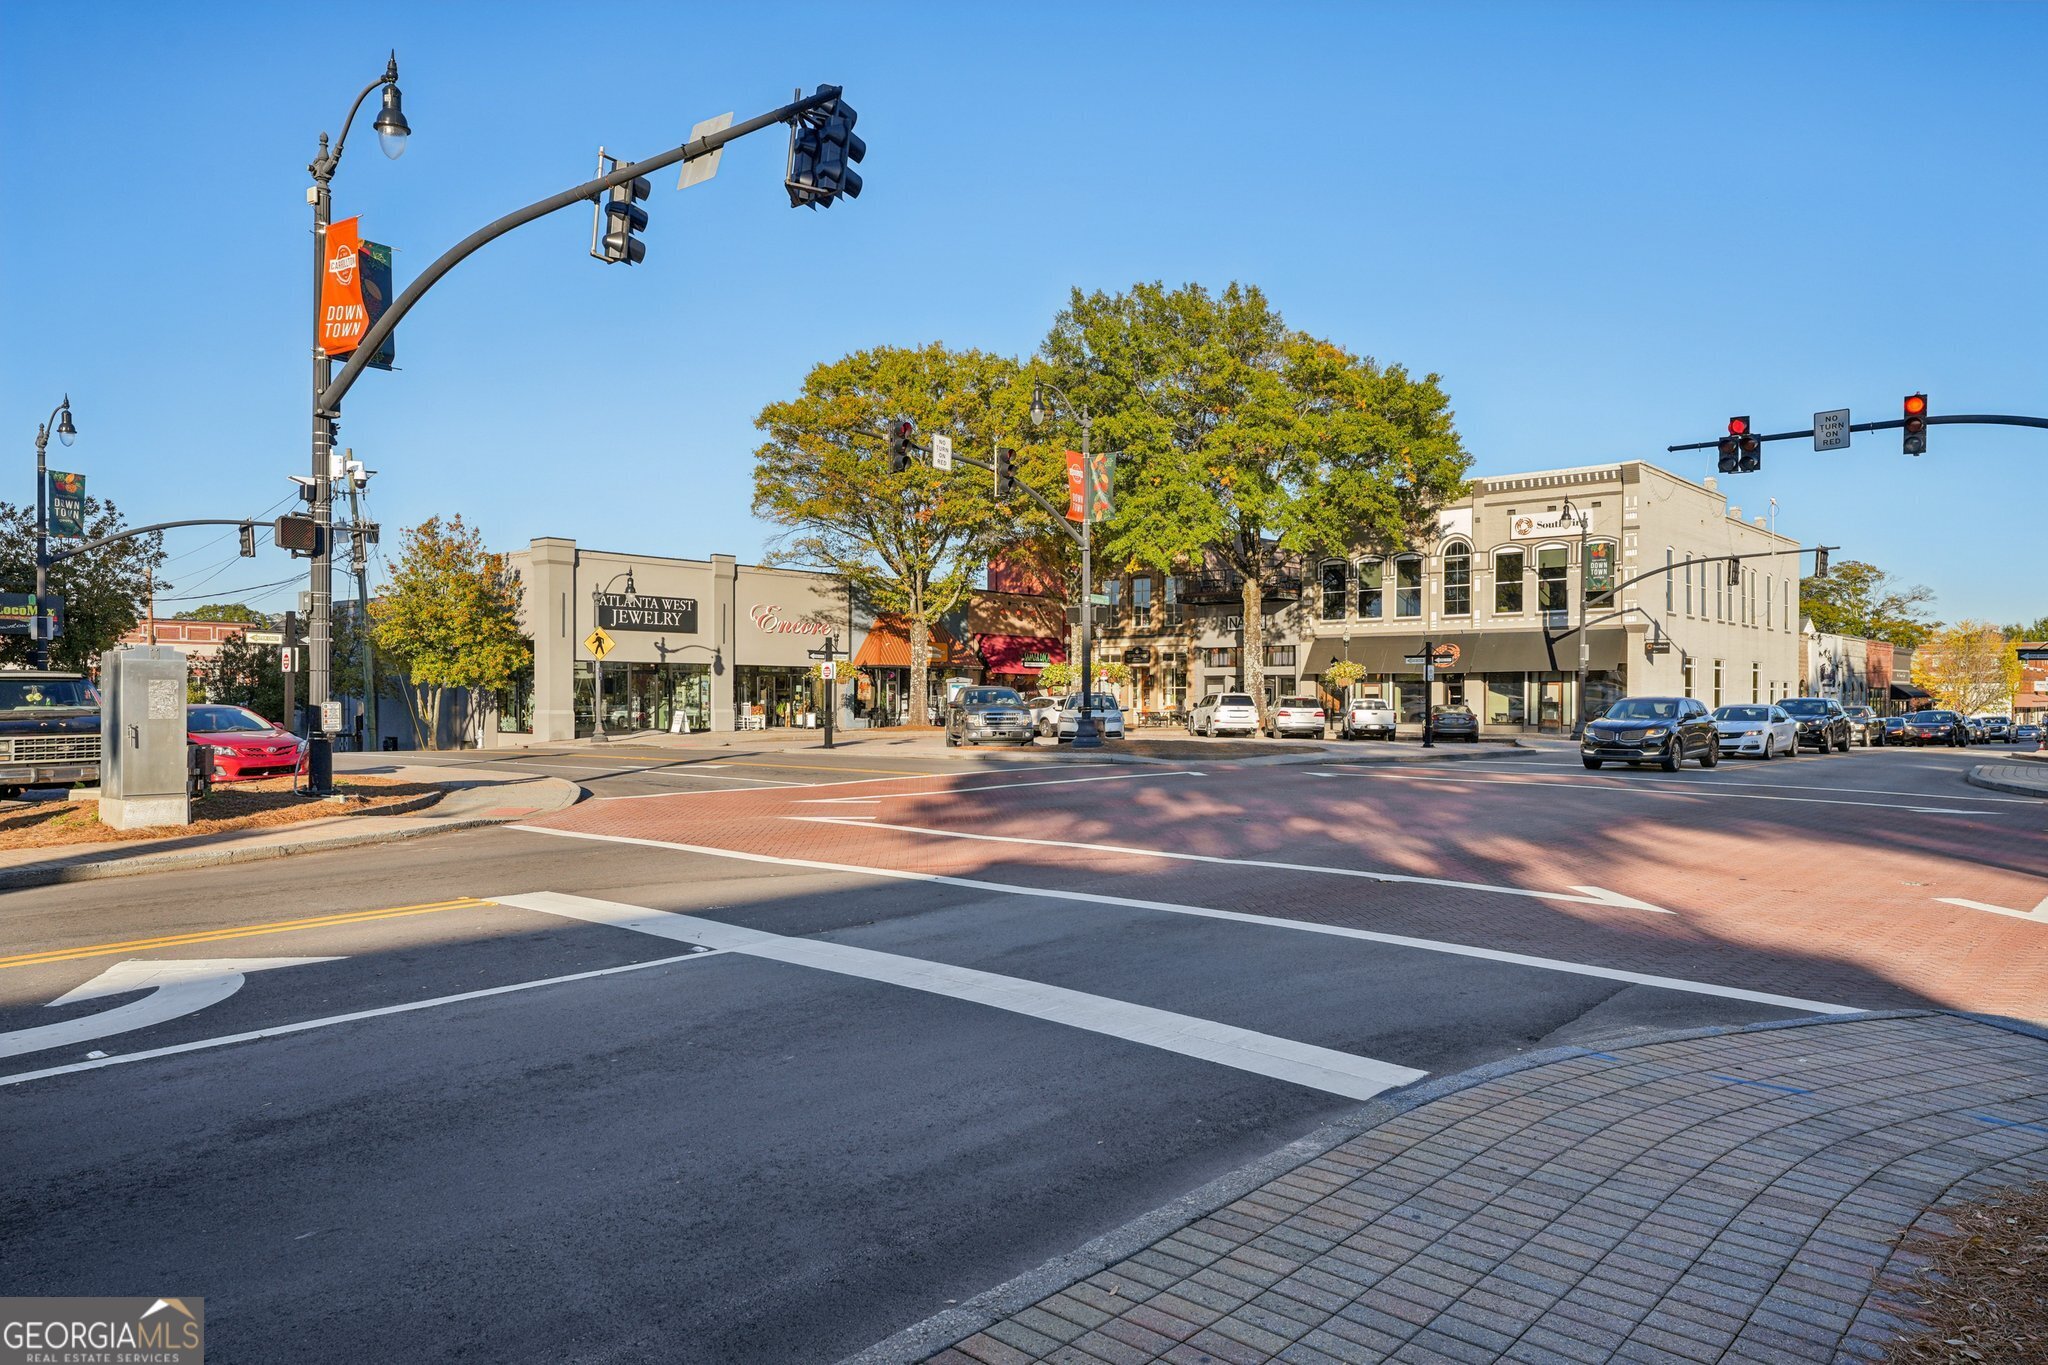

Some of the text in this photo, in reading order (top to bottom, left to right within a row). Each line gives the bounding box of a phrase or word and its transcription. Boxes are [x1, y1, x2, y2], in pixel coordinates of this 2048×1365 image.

[327, 304, 363, 320] DOWN
[325, 322, 361, 338] TOWN
[1819, 422, 1844, 430] TURN
[1823, 438, 1841, 446] RED
[54, 498, 80, 510] DOWN
[54, 508, 80, 519] TOWN
[600, 595, 694, 611] ATLANTA WEST
[611, 609, 682, 627] JEWELRY
[750, 604, 832, 635] Encore
